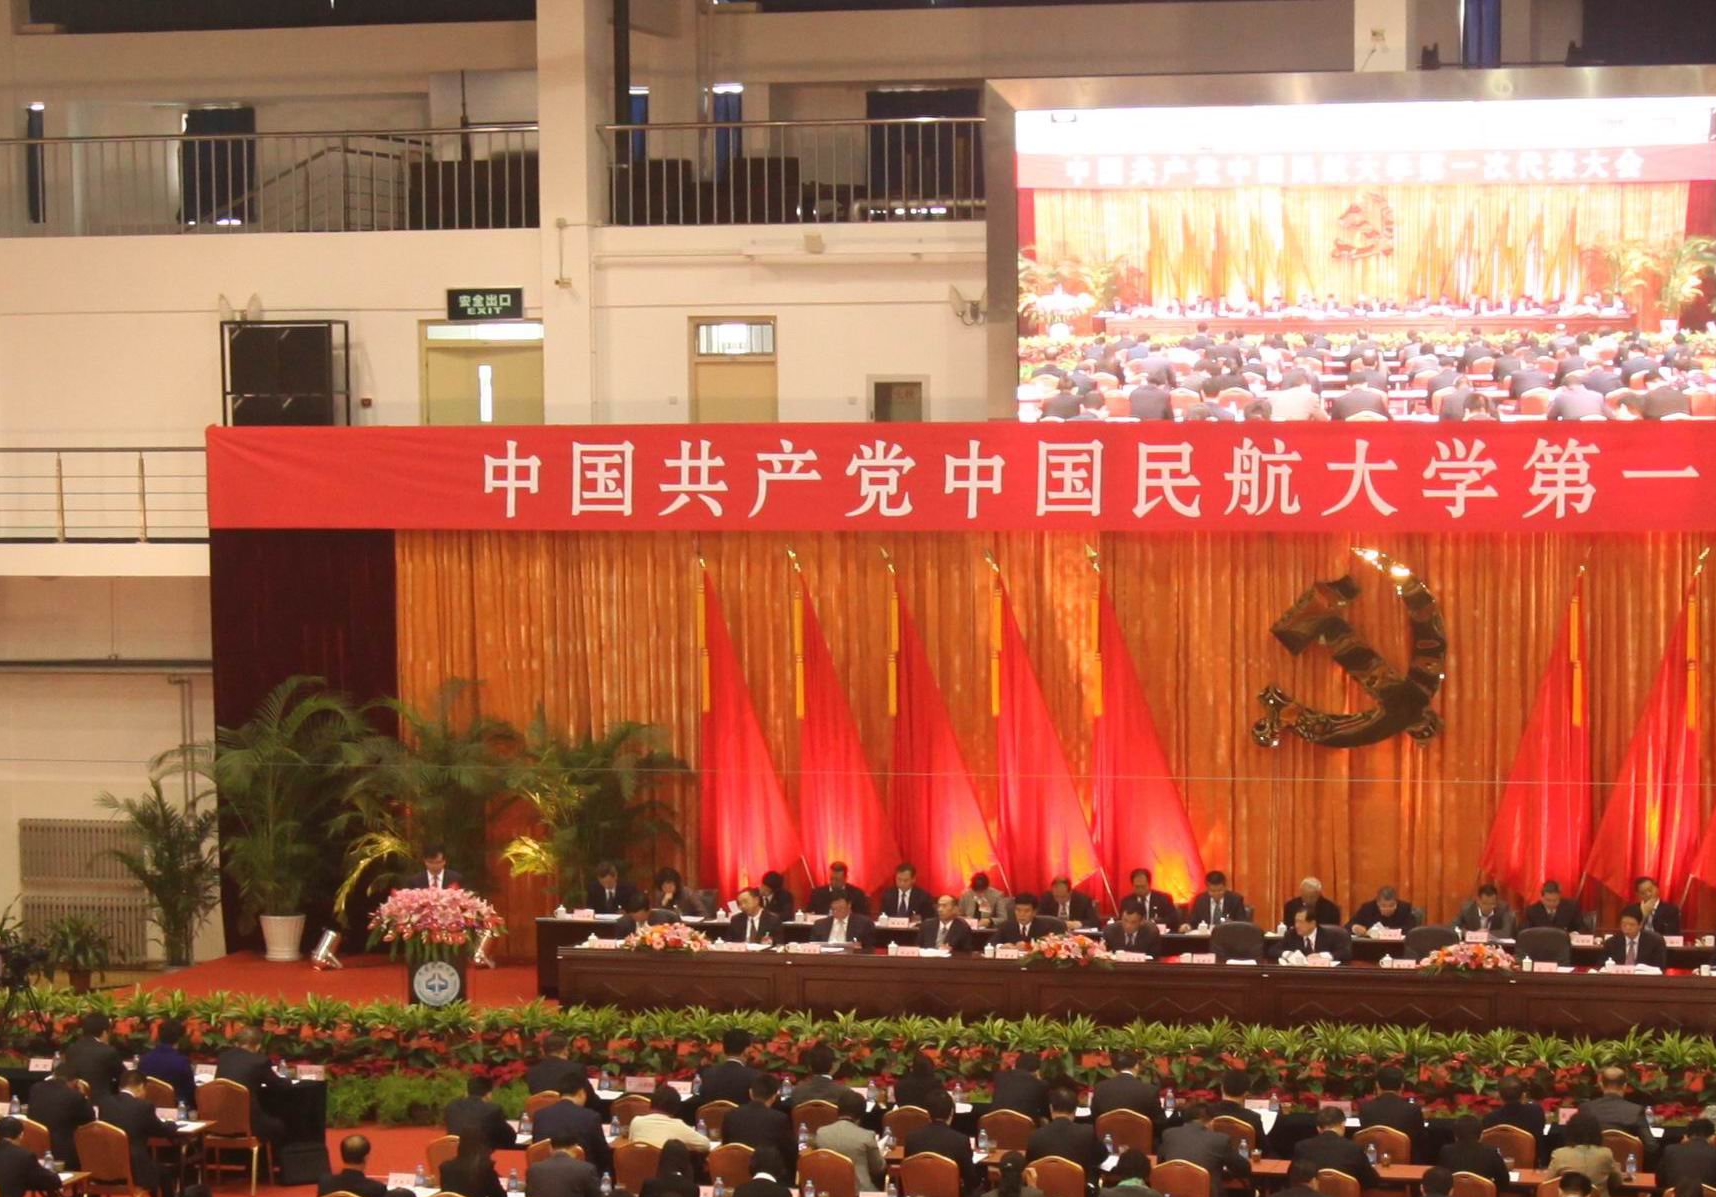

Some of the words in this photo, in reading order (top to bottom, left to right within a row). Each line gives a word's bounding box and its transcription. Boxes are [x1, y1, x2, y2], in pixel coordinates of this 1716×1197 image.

[459, 294, 511, 307] 安全出口
[467, 307, 502, 315] EXIT
